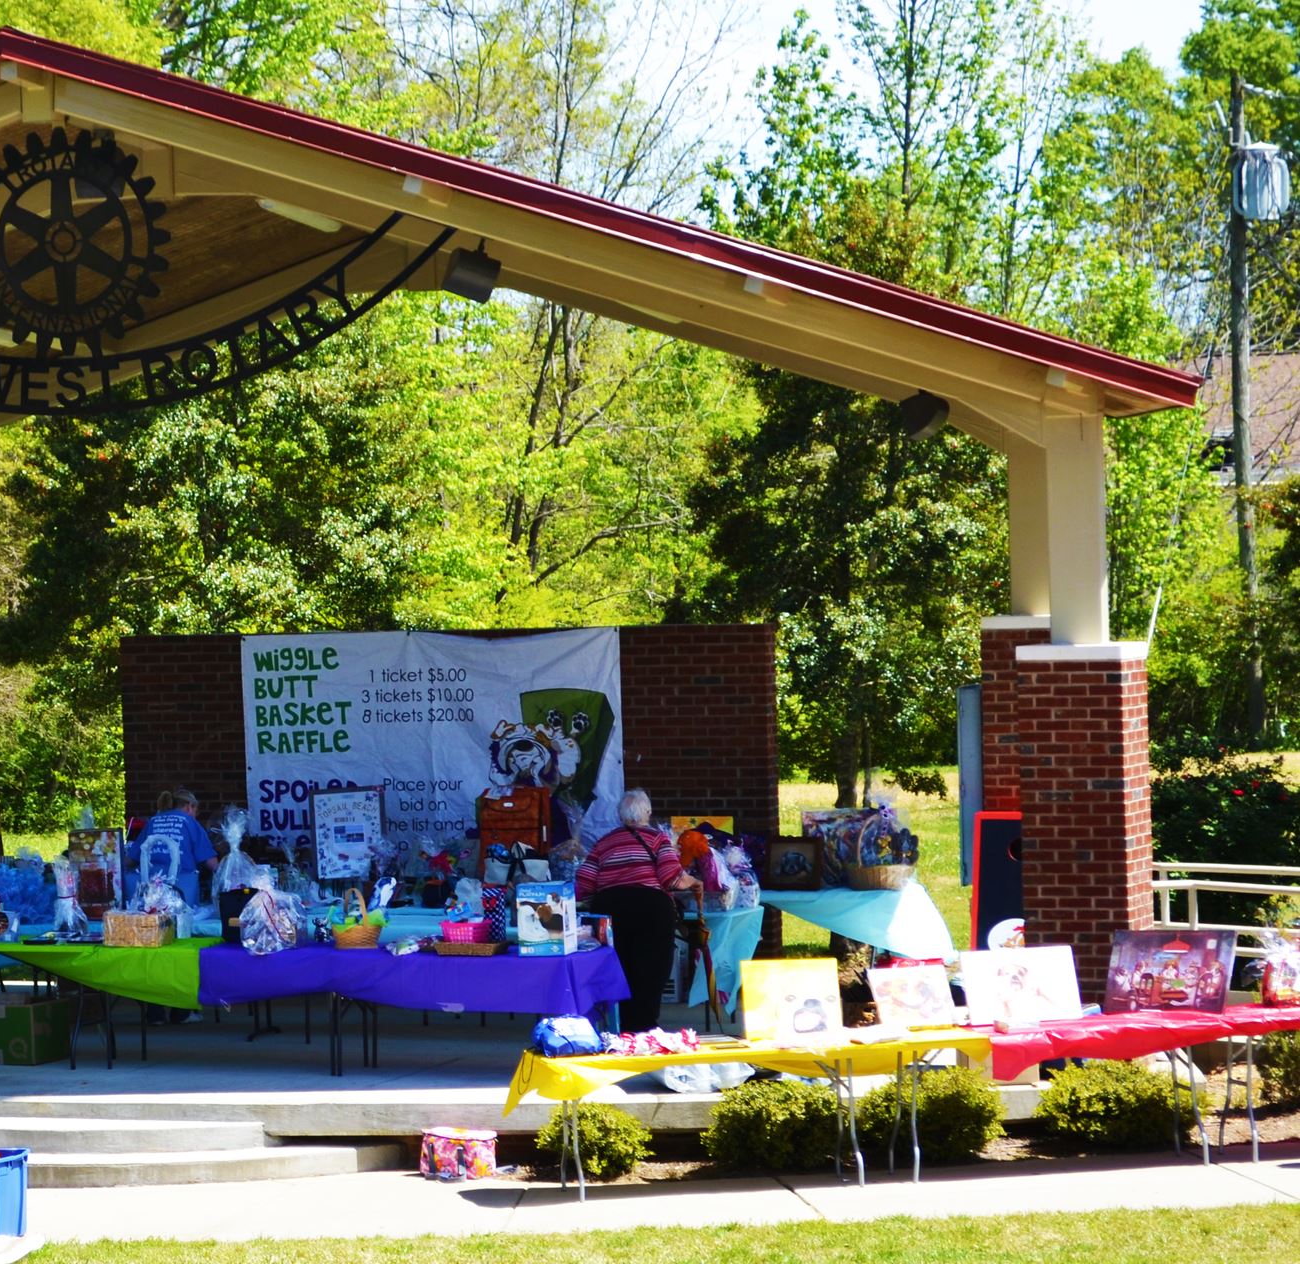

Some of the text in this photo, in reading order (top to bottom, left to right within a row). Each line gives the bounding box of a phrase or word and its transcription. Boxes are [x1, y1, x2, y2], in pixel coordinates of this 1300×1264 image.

[141, 264, 354, 399] ROTARY
[369, 667, 467, 684] 1 ticket $5.00
[254, 675, 318, 699] BUTT
[361, 687, 474, 704] 3 tickets $10.00
[362, 707, 474, 724] 8 tickets $20.00
[383, 777, 463, 794] Place your
[399, 798, 447, 812] bid on
[387, 817, 464, 831] he list and
